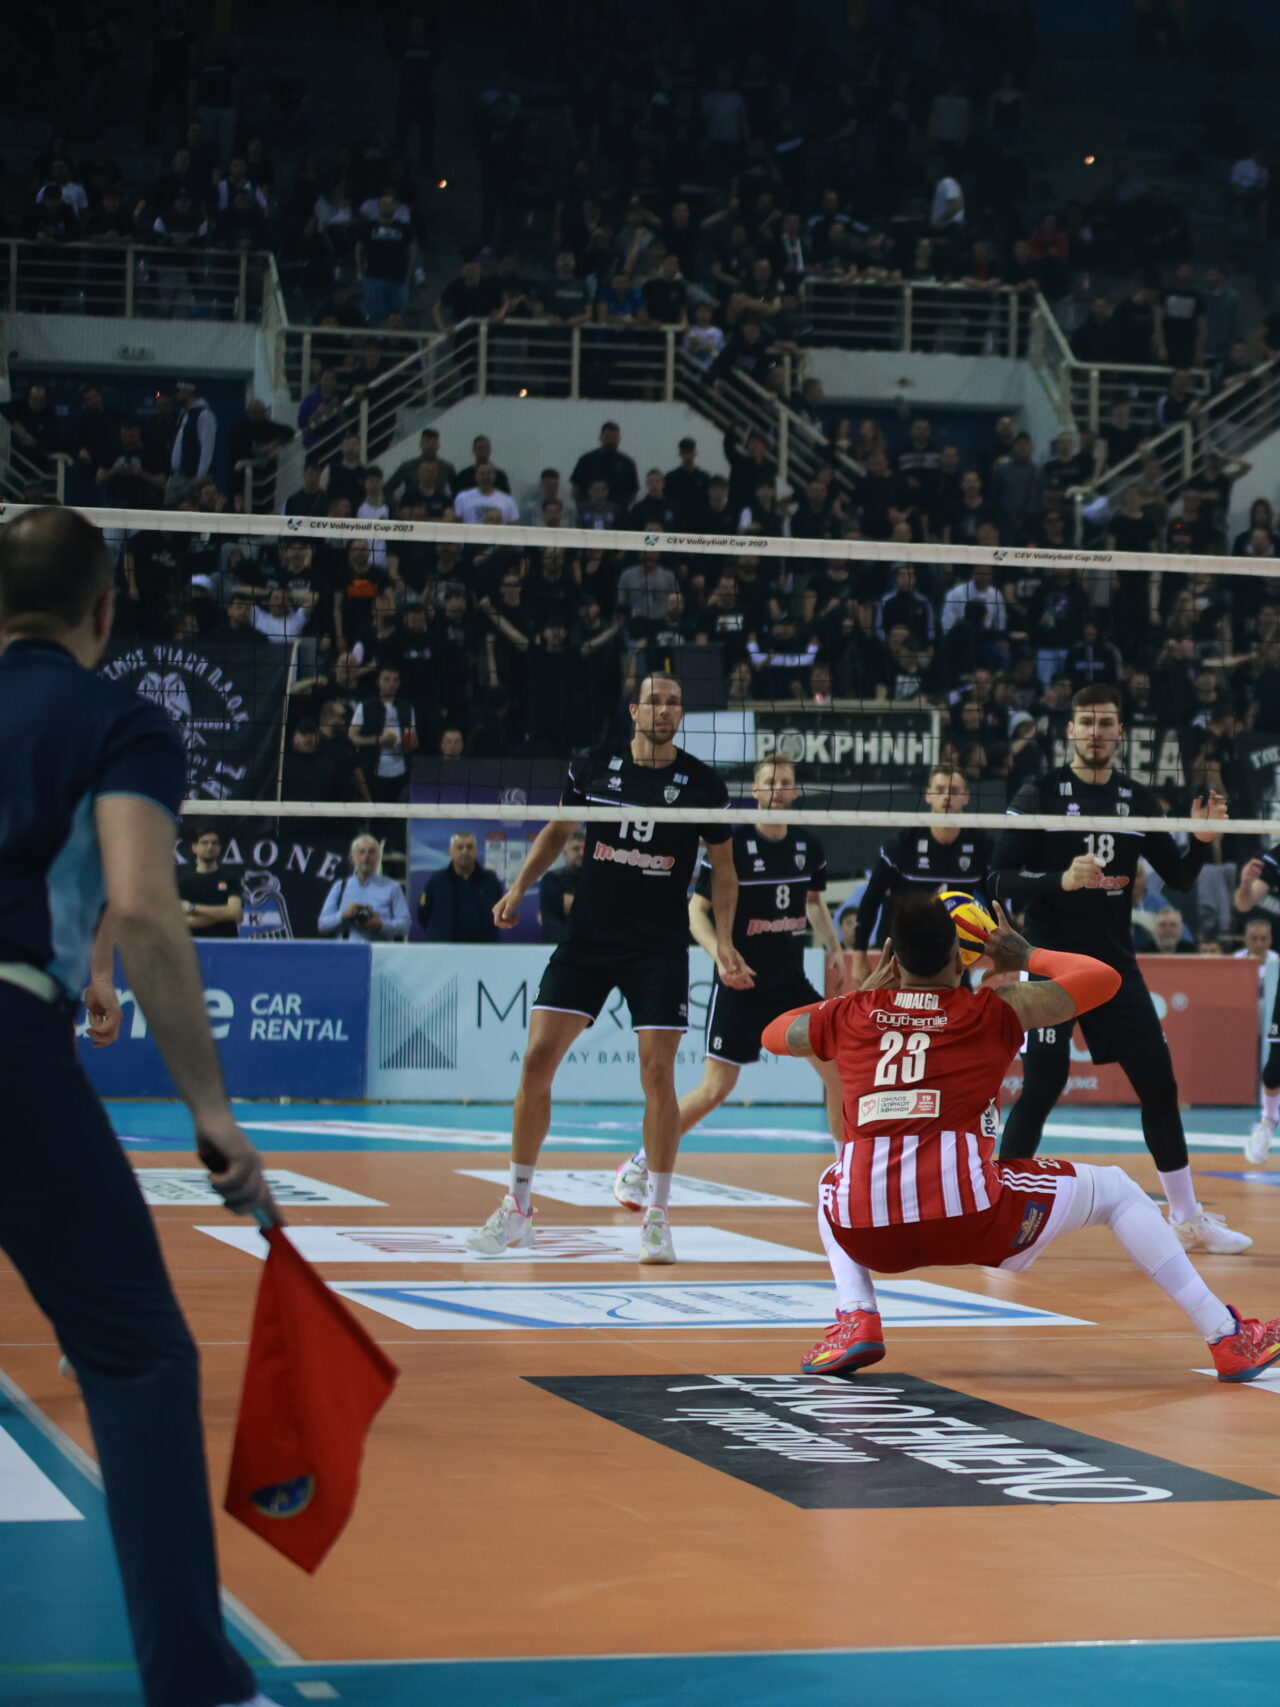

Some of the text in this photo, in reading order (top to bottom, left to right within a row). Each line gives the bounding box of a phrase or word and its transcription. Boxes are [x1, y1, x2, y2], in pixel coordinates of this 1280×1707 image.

[309, 521, 415, 532] CEV Volleyball Cup 2023
[666, 537, 768, 548] CEV Volleyball Cup 2023
[1014, 552, 1113, 563] CEV Volleyball Cup 2023
[618, 821, 656, 843] 19
[592, 840, 676, 871] mateco
[1083, 833, 1116, 865] 18
[775, 884, 791, 910] 8
[250, 993, 302, 1016] CAR
[893, 992, 940, 1011] HIDALGO
[876, 1012, 948, 1027] buythemile
[250, 1018, 349, 1041] RENTAL
[1037, 1027, 1057, 1045] 18
[712, 1036, 723, 1051] 8
[873, 1030, 932, 1087] 23
[880, 1095, 908, 1103] ΟΜΙΛΟΣ
[921, 1094, 933, 1102] 19
